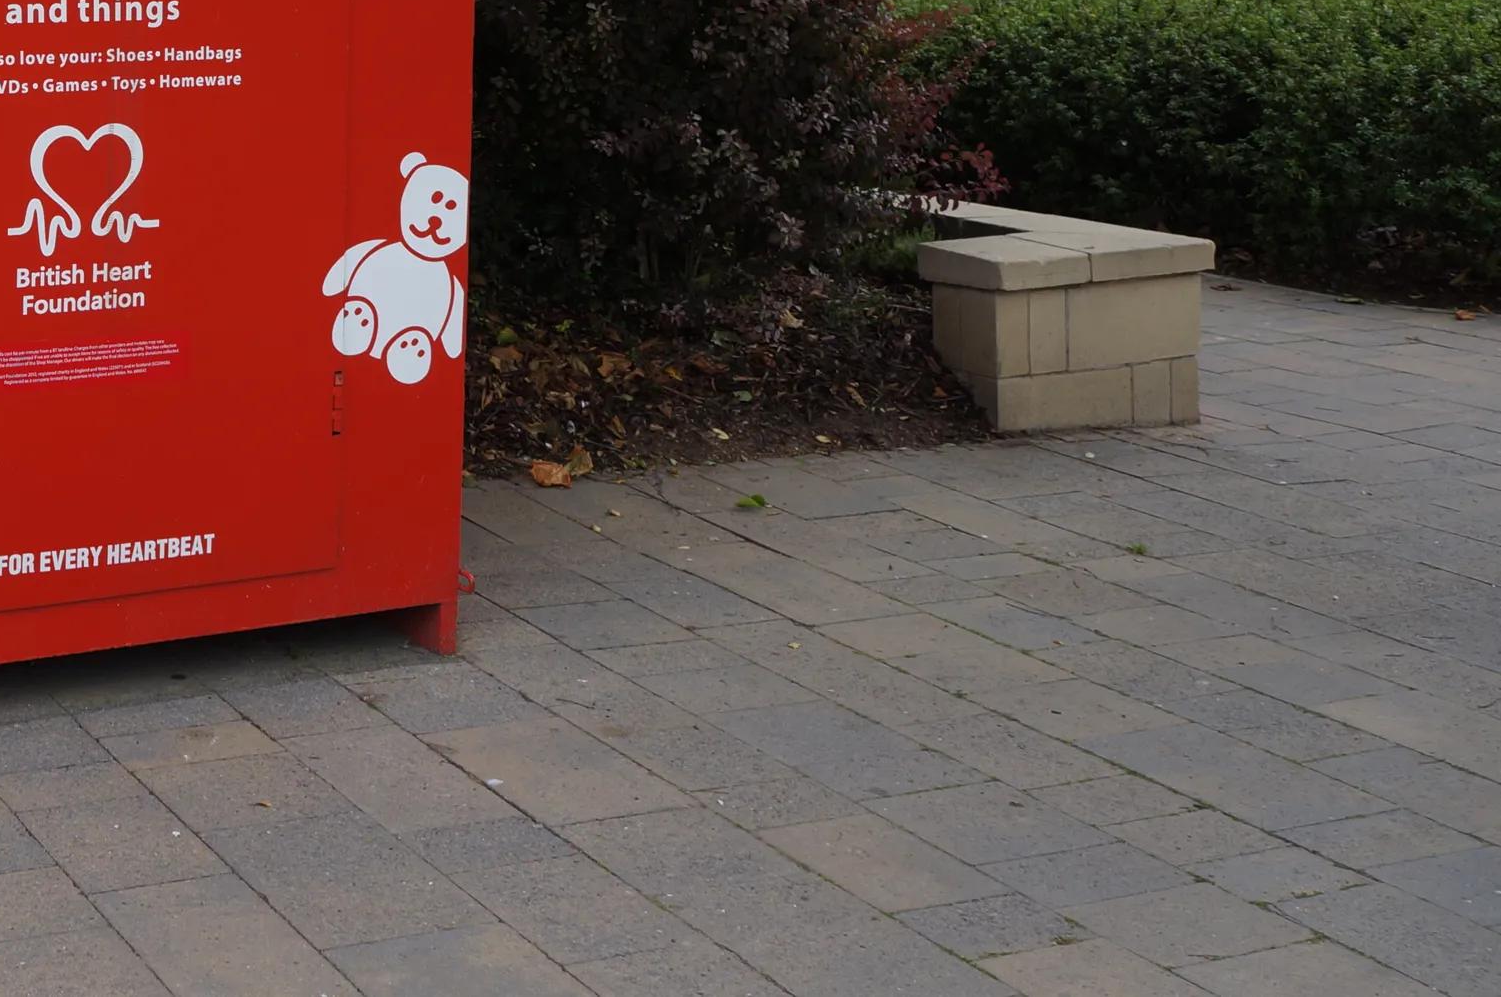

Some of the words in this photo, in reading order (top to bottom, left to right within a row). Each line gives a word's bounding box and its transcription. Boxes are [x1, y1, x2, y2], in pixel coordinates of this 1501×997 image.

[20, 50, 54, 65] love
[60, 51, 102, 67] your:
[164, 46, 242, 62] Handbags
[43, 78, 98, 92] Games
[112, 76, 146, 93] Toys
[159, 74, 242, 89] Homeware
[17, 264, 84, 288] British
[93, 261, 151, 282] Heart
[23, 289, 144, 315] Foundation
[40, 546, 103, 572] EVERY
[107, 534, 215, 565] HEARTBEAT
